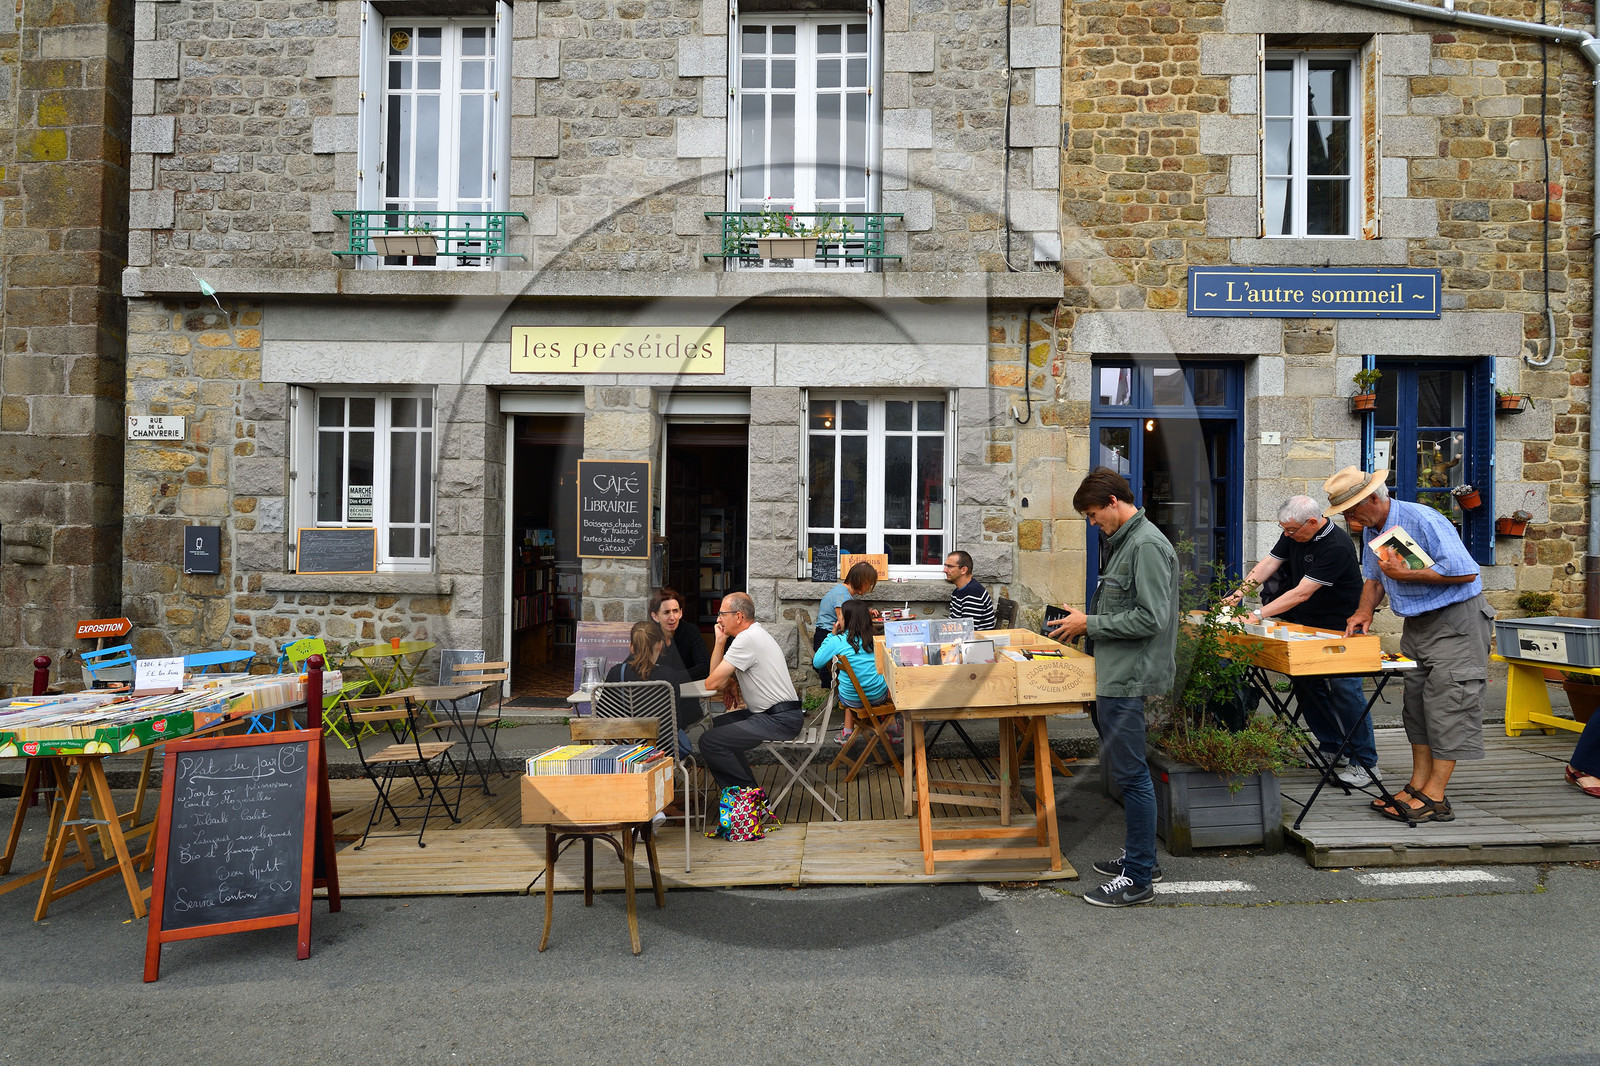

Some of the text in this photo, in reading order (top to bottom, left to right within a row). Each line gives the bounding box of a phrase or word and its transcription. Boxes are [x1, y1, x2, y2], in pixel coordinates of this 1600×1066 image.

[1225, 281, 1404, 304] L'autre sommeil
[522, 334, 561, 359] les
[1268, 434, 1274, 442] 7
[583, 519, 613, 528] Boissons
[77, 622, 124, 634] EXPOSITION
[1025, 664, 1044, 681] CLOS
[1052, 660, 1086, 678] MARQUIS
[1037, 684, 1062, 693] JULIEN
[1062, 677, 1083, 693] MEDOC
